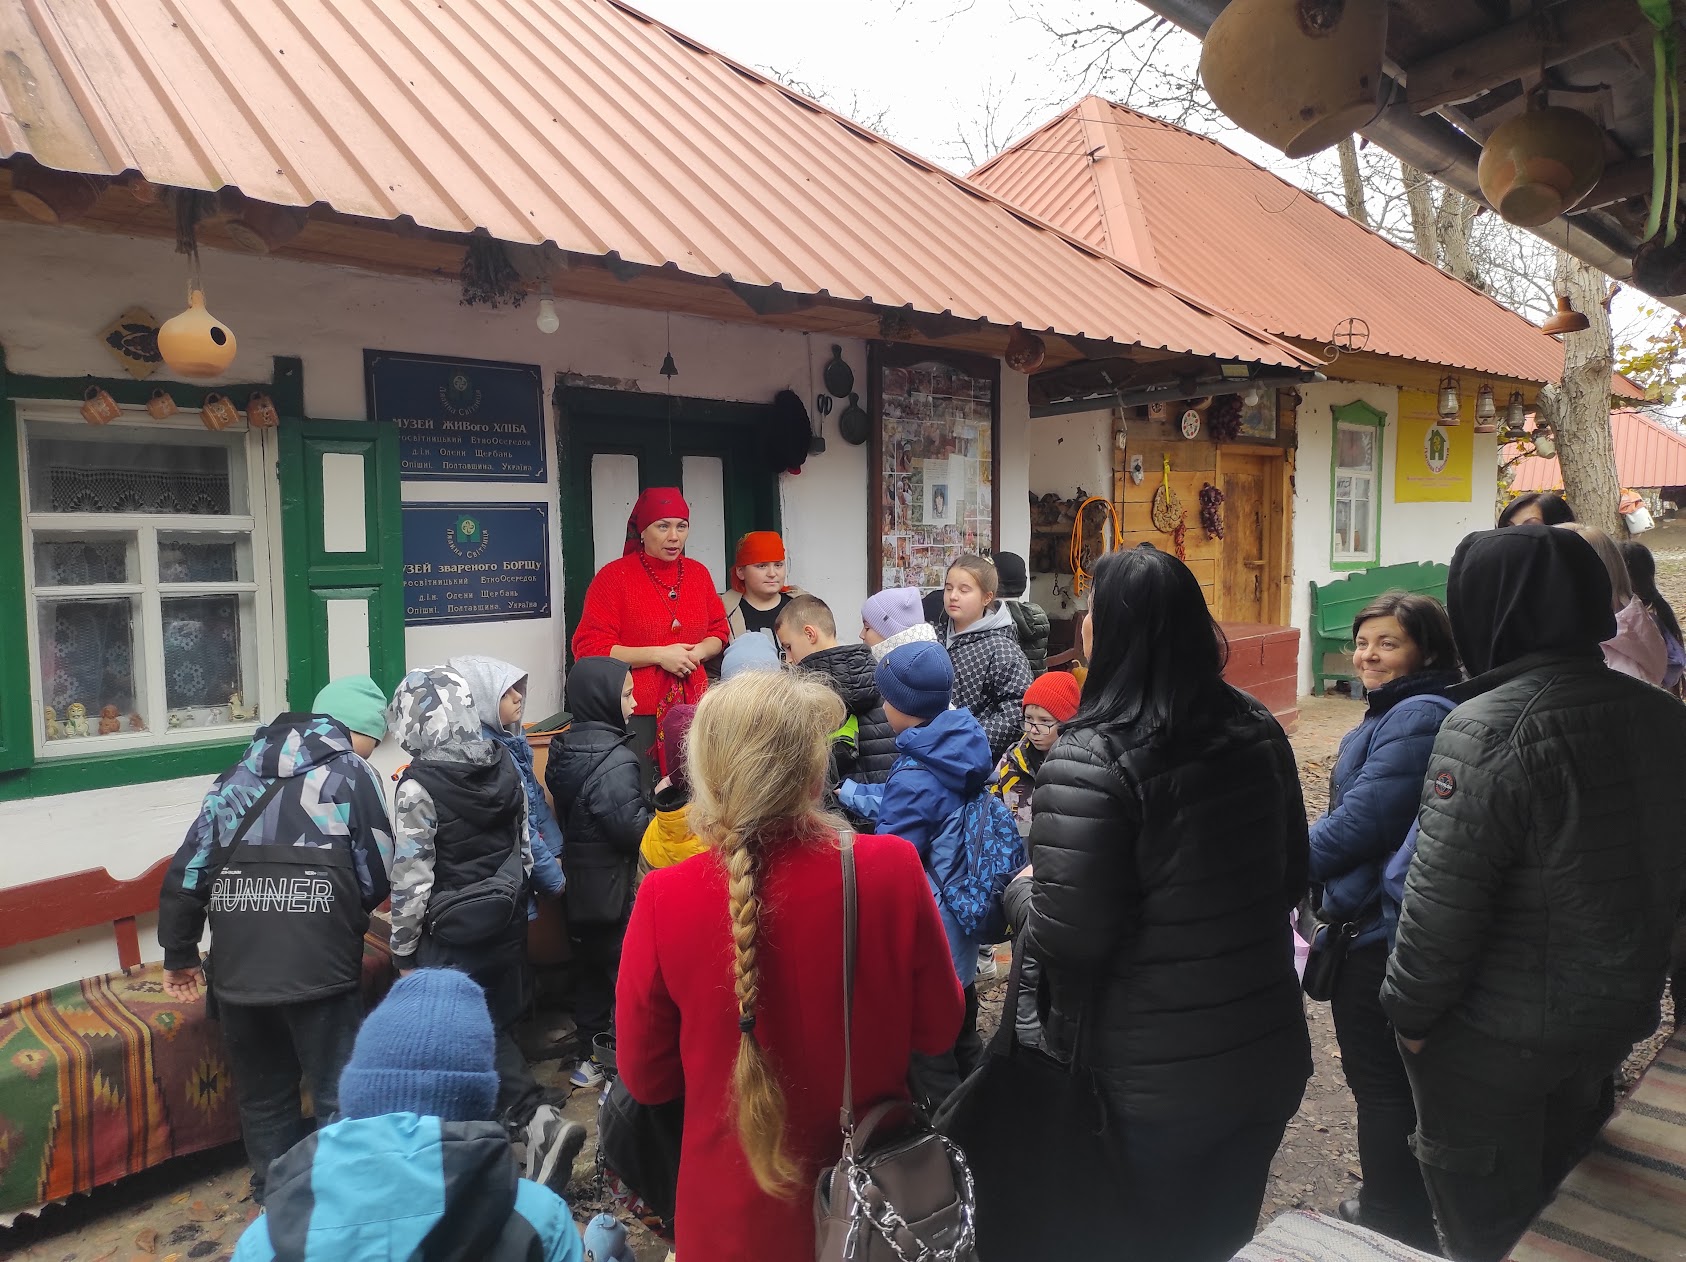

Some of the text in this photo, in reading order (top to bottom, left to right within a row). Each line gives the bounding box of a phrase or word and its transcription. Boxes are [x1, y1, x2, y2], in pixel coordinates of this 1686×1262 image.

[493, 423, 527, 434] ХЛІБА
[398, 434, 462, 443] освітницький
[440, 448, 466, 457] Олени
[475, 449, 513, 458] Щербань
[502, 462, 532, 471] Україна
[438, 563, 498, 574] звареного
[503, 560, 541, 571] БОРЩу
[446, 591, 474, 600] Олени
[481, 589, 519, 599] Щербань
[507, 600, 538, 609] Україна
[210, 877, 334, 913] RUNNER
